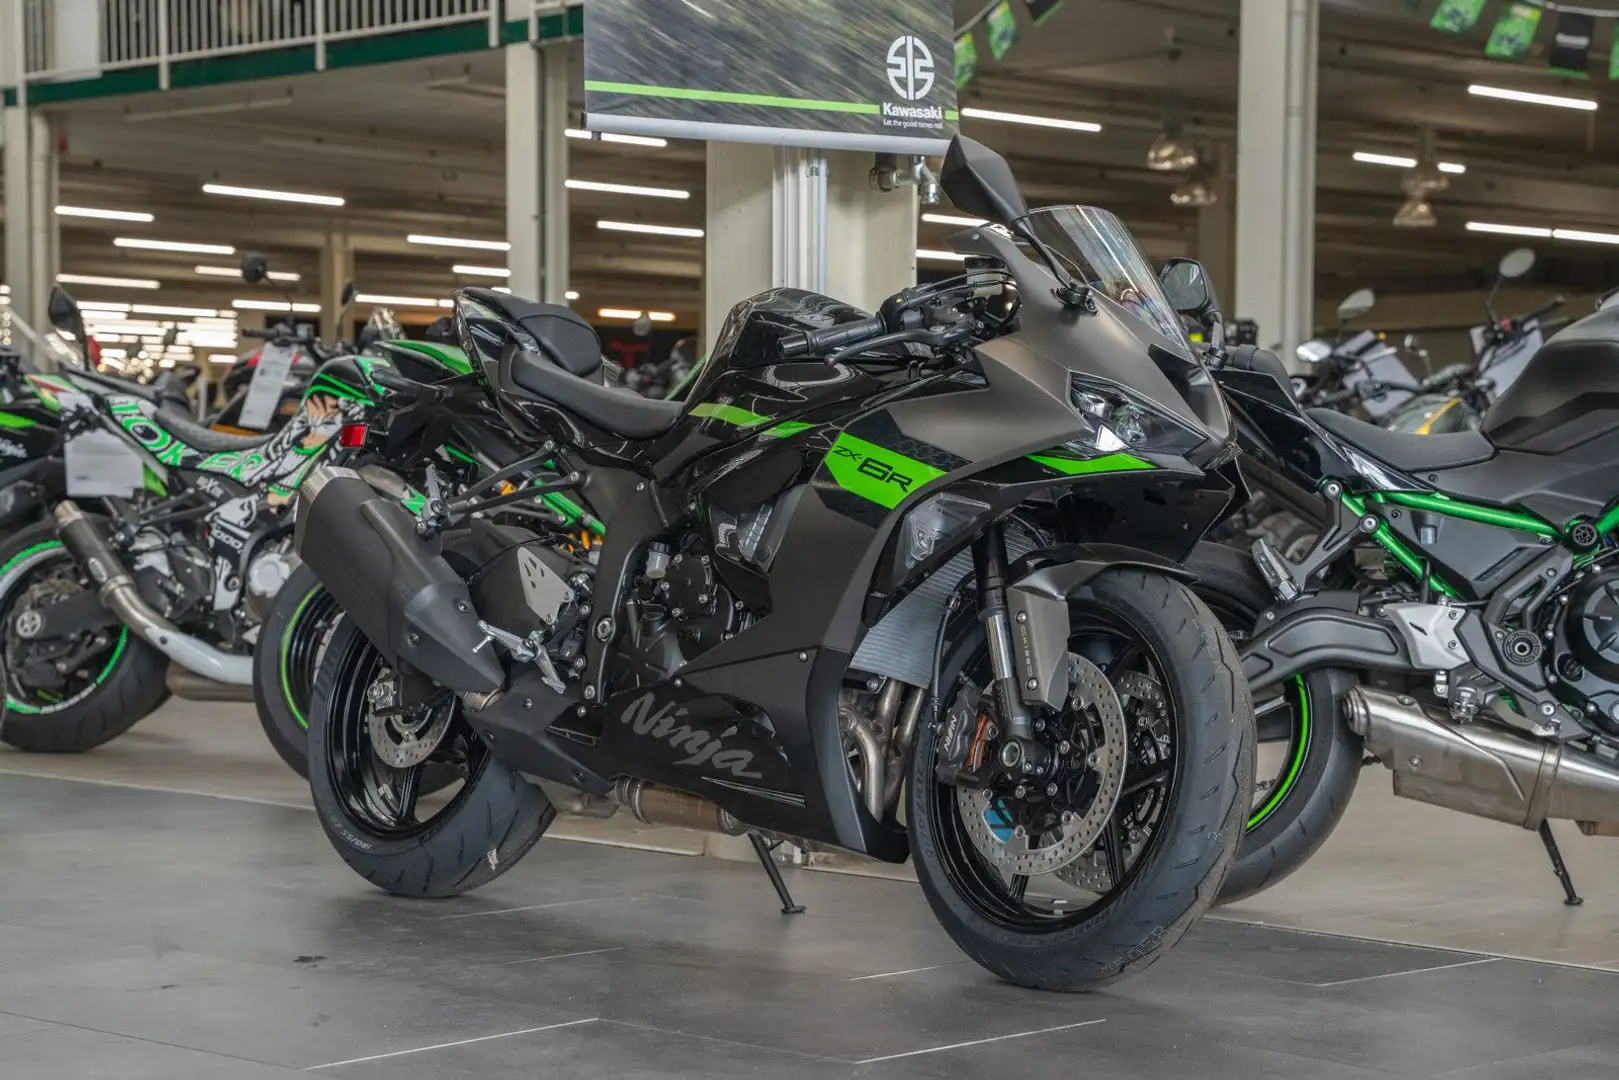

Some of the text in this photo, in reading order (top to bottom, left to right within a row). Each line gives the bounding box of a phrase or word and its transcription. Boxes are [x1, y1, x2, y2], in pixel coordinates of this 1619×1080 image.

[882, 101, 942, 119] Kawasaki
[883, 118, 892, 126] Let
[903, 120, 918, 128] good
[832, 445, 914, 493] ZX-6R
[620, 692, 763, 780] Ninja
